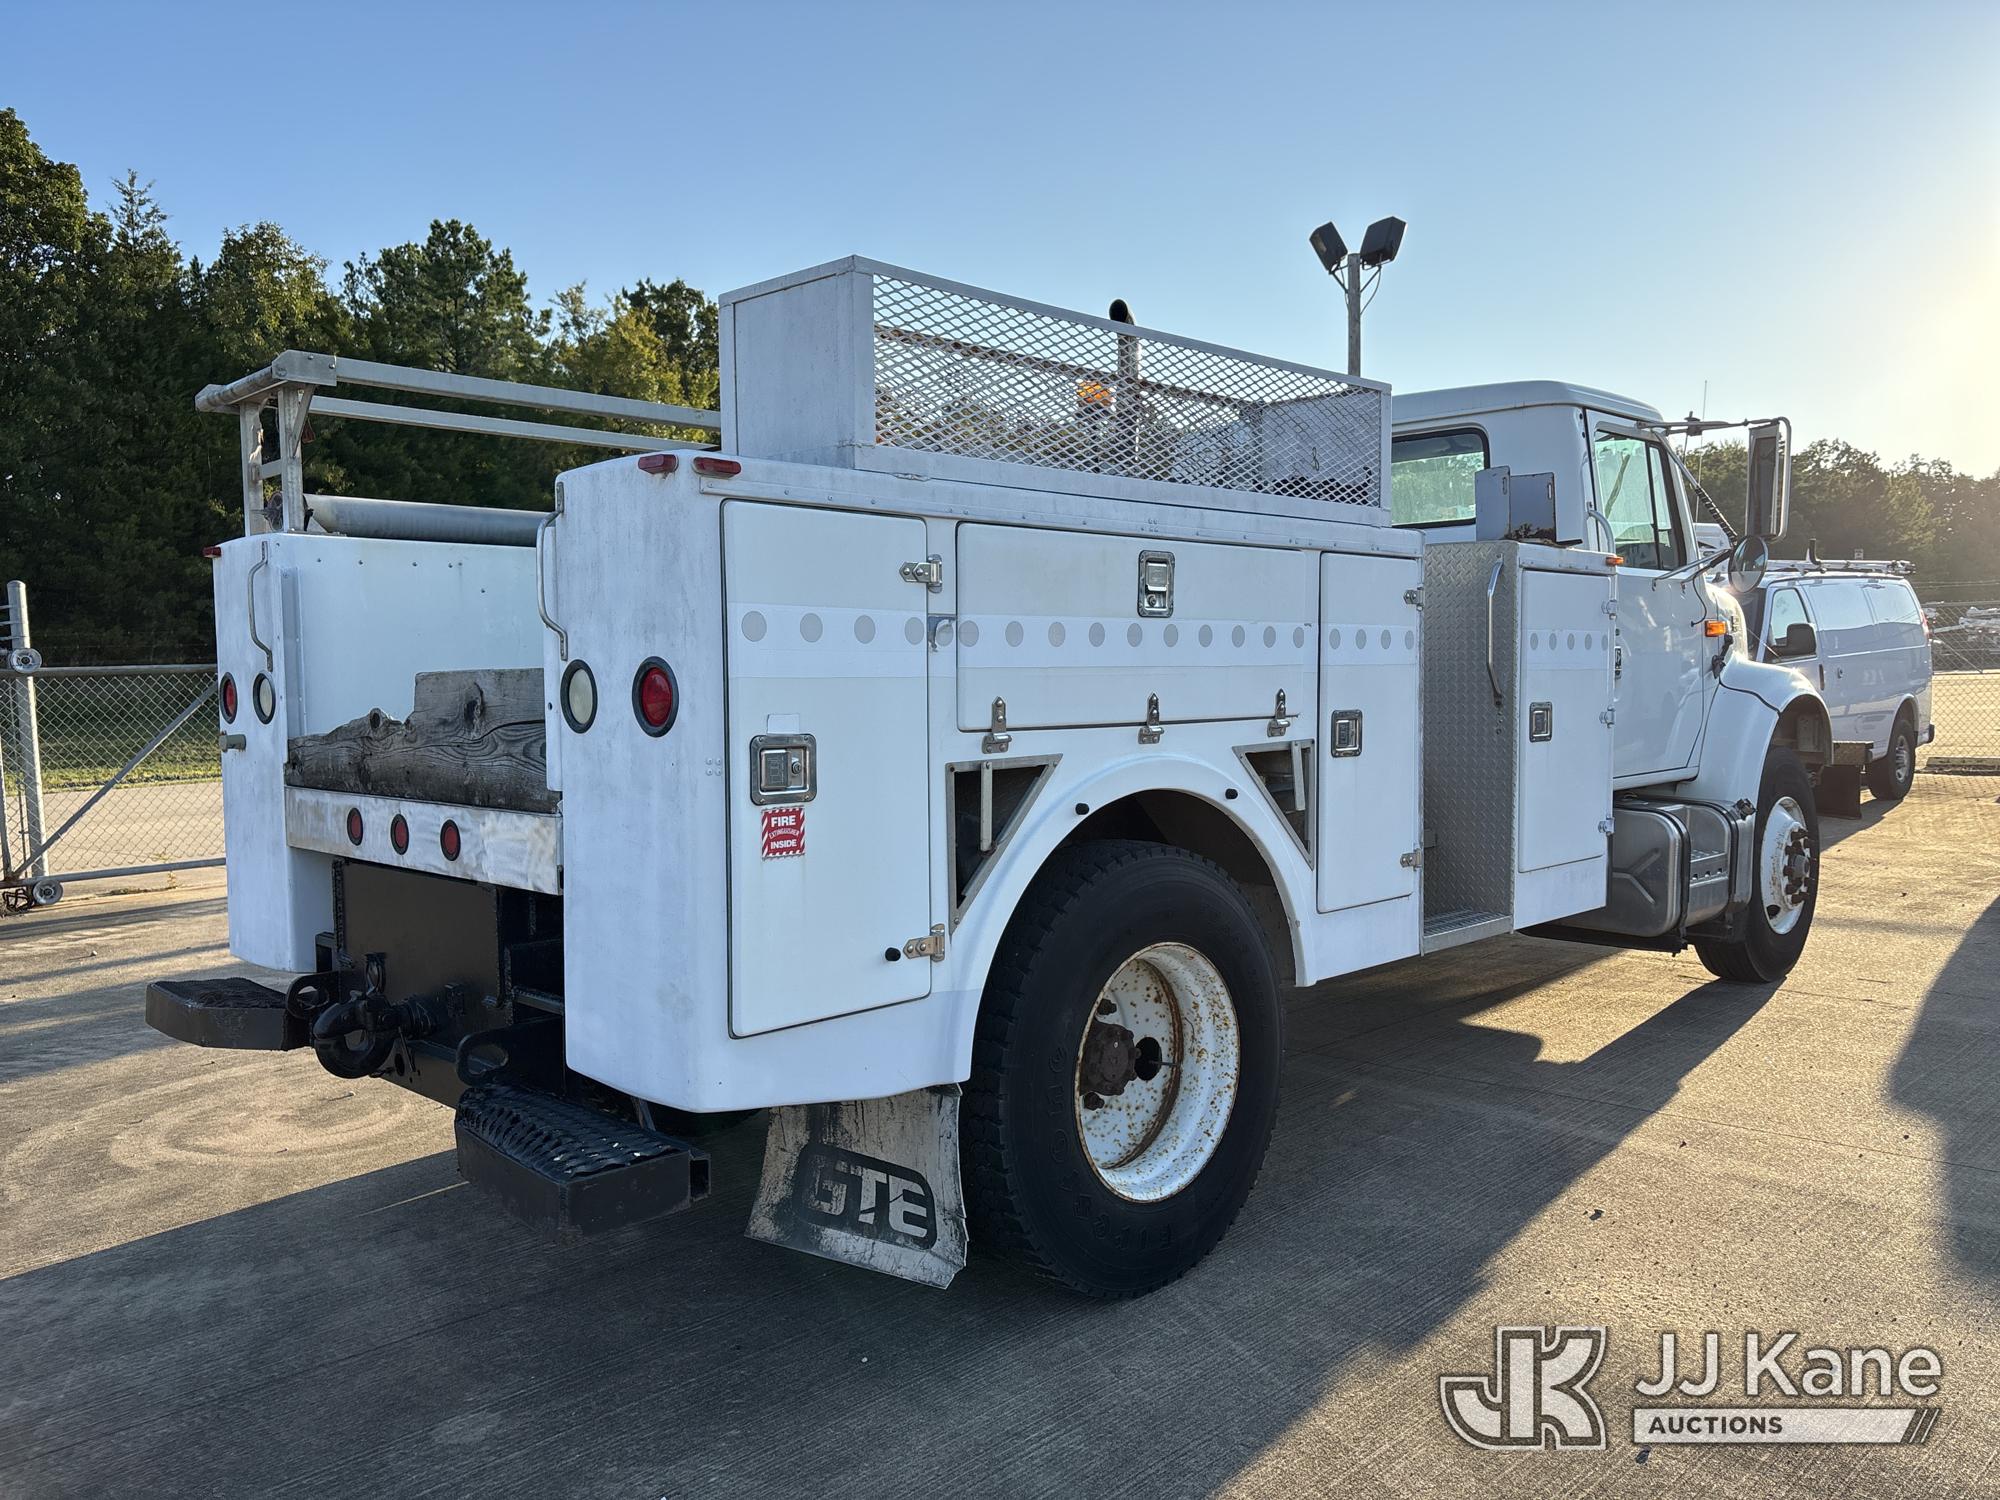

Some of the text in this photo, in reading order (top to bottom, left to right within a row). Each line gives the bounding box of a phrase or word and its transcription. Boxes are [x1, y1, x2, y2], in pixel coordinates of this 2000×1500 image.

[771, 815, 796, 828] FIRE
[770, 839, 797, 850] INSIDE
[806, 1153, 929, 1239] GTE
